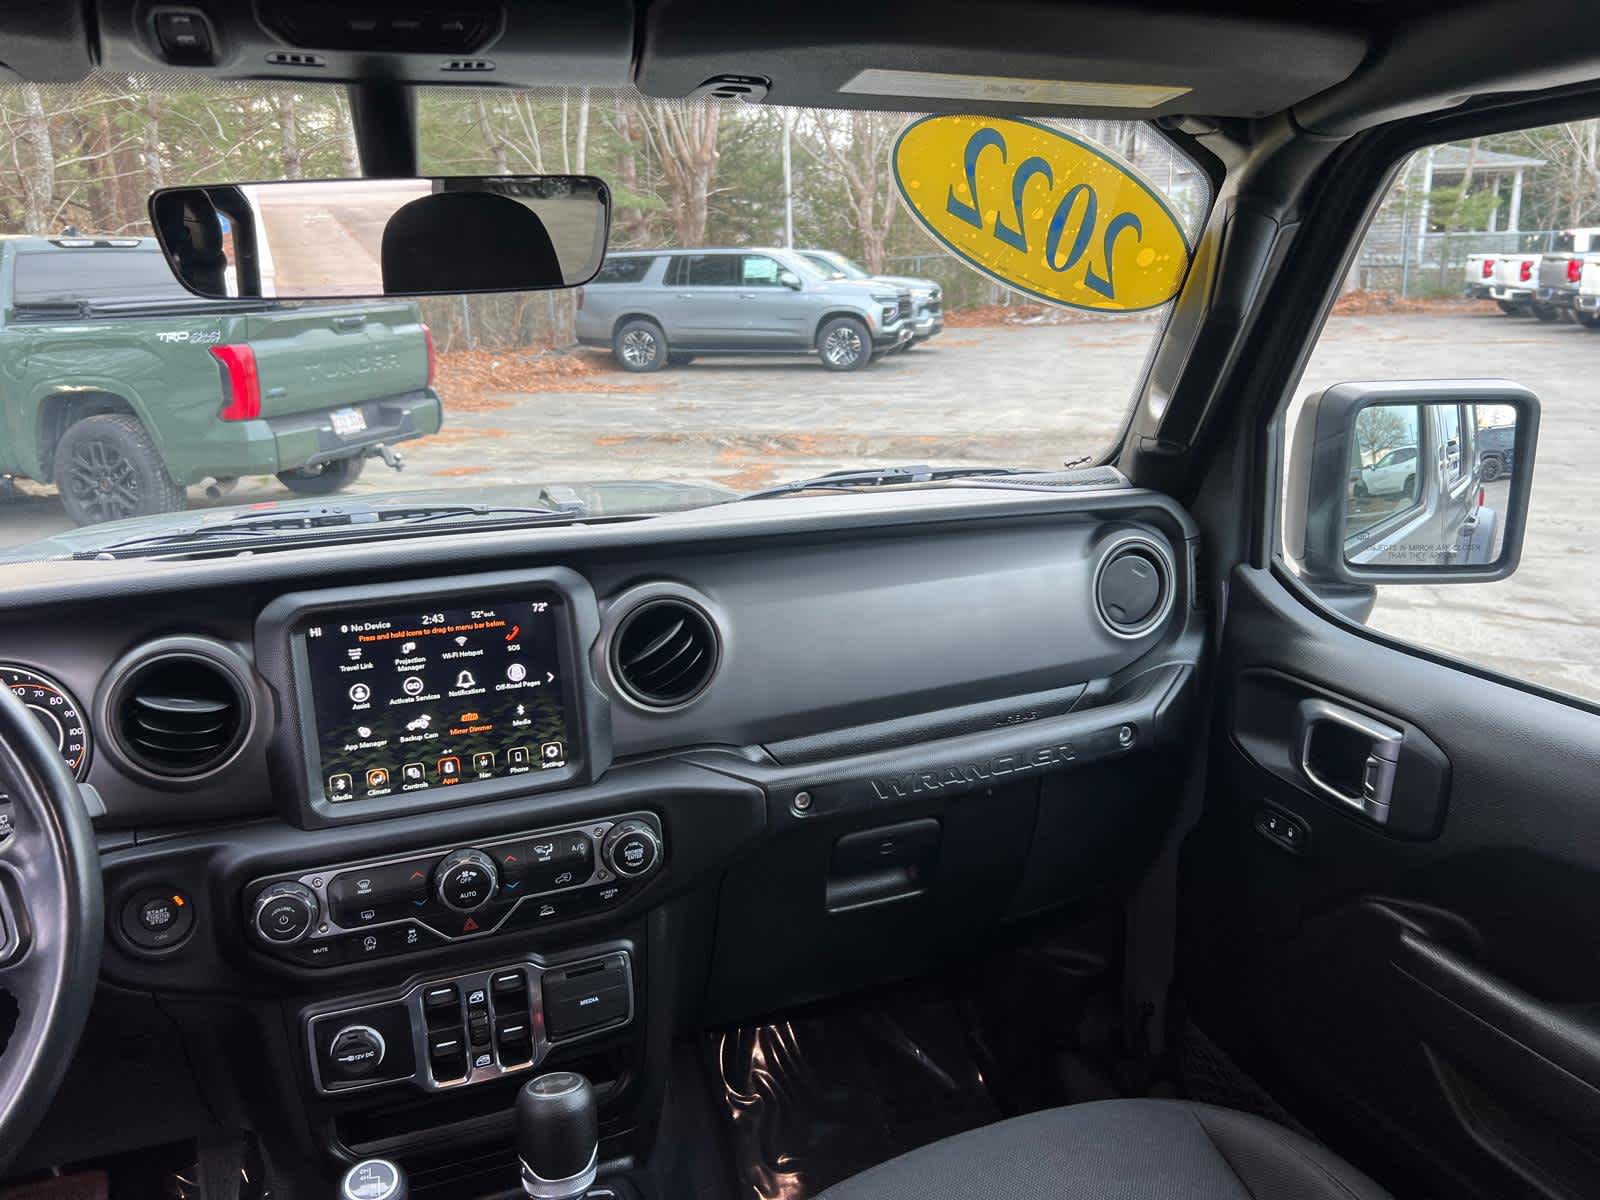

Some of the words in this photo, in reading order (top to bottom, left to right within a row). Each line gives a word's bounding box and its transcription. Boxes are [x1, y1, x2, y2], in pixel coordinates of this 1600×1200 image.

[421, 613, 445, 625] 2:43
[350, 624, 364, 633] No
[364, 621, 392, 632] Device
[377, 632, 390, 641] and
[391, 631, 405, 640] hold
[431, 626, 447, 635] drag
[447, 625, 455, 633] to
[455, 624, 474, 632] menu
[474, 622, 485, 630] bar
[33, 689, 45, 698] 70
[49, 696, 64, 705] 80
[64, 710, 76, 719] 90
[69, 727, 83, 737] 100
[69, 744, 81, 752] 110
[871, 742, 1077, 800] WRANGLER
[571, 842, 585, 852] A/C
[460, 890, 477, 899] AUTO
[312, 946, 329, 954] MUTE
[580, 996, 599, 1006] MEDIA
